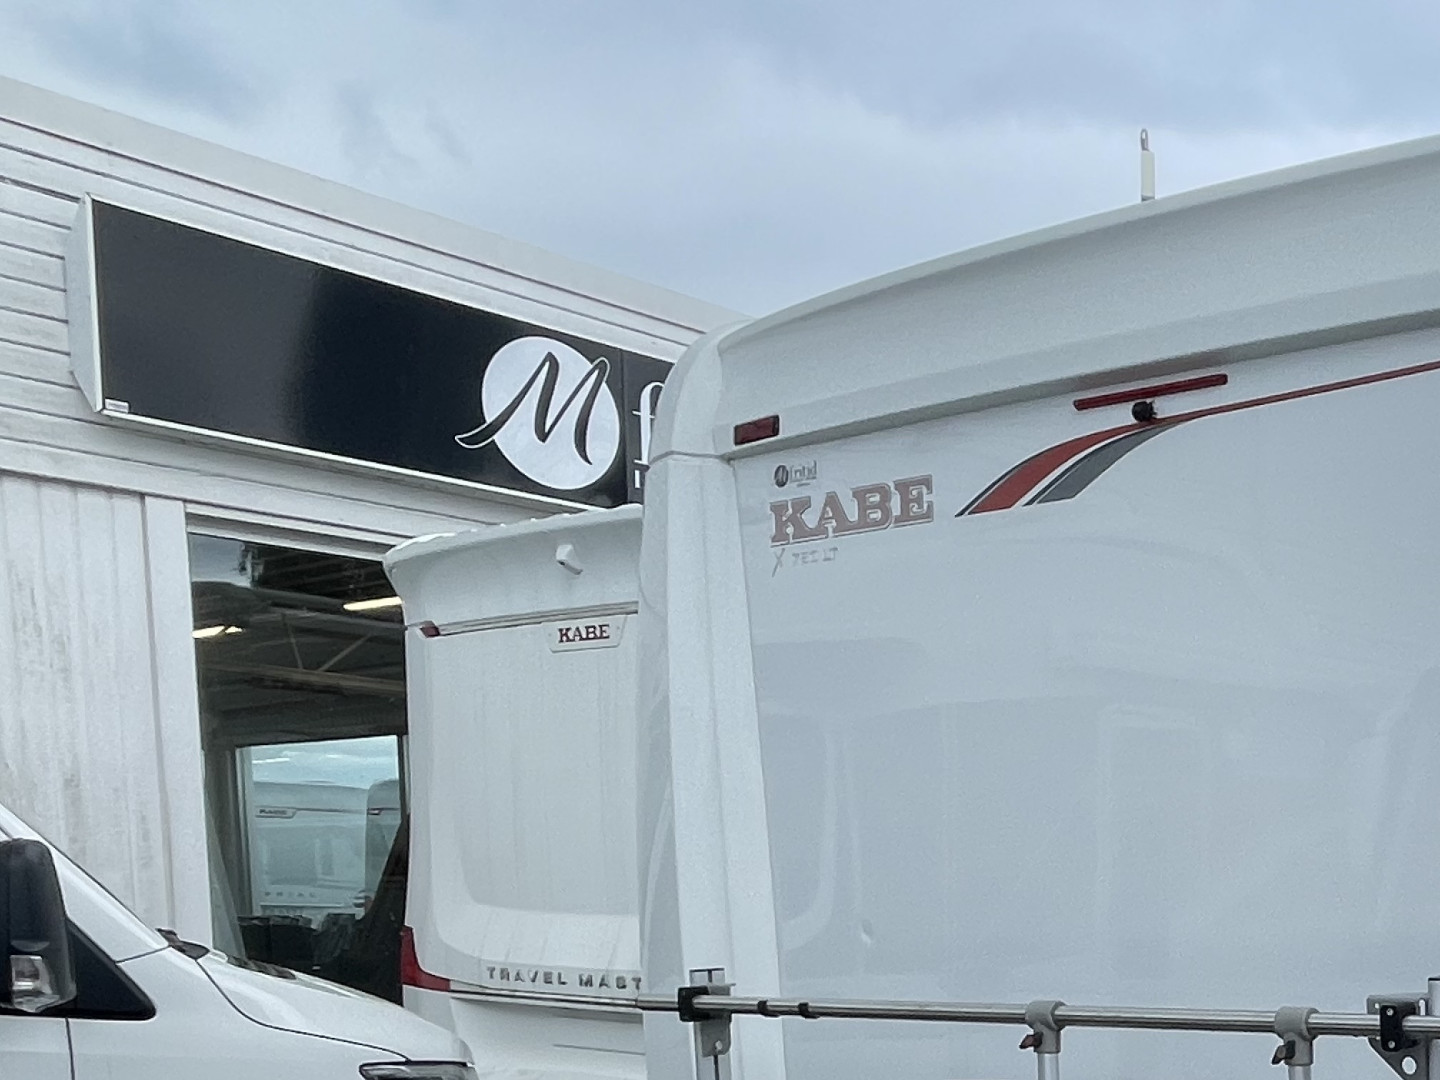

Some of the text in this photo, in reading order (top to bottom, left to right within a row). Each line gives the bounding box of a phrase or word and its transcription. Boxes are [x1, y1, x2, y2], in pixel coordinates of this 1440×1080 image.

[769, 474, 935, 548] KABE
[558, 624, 611, 644] KABE
[486, 966, 569, 986] TRAVEL
